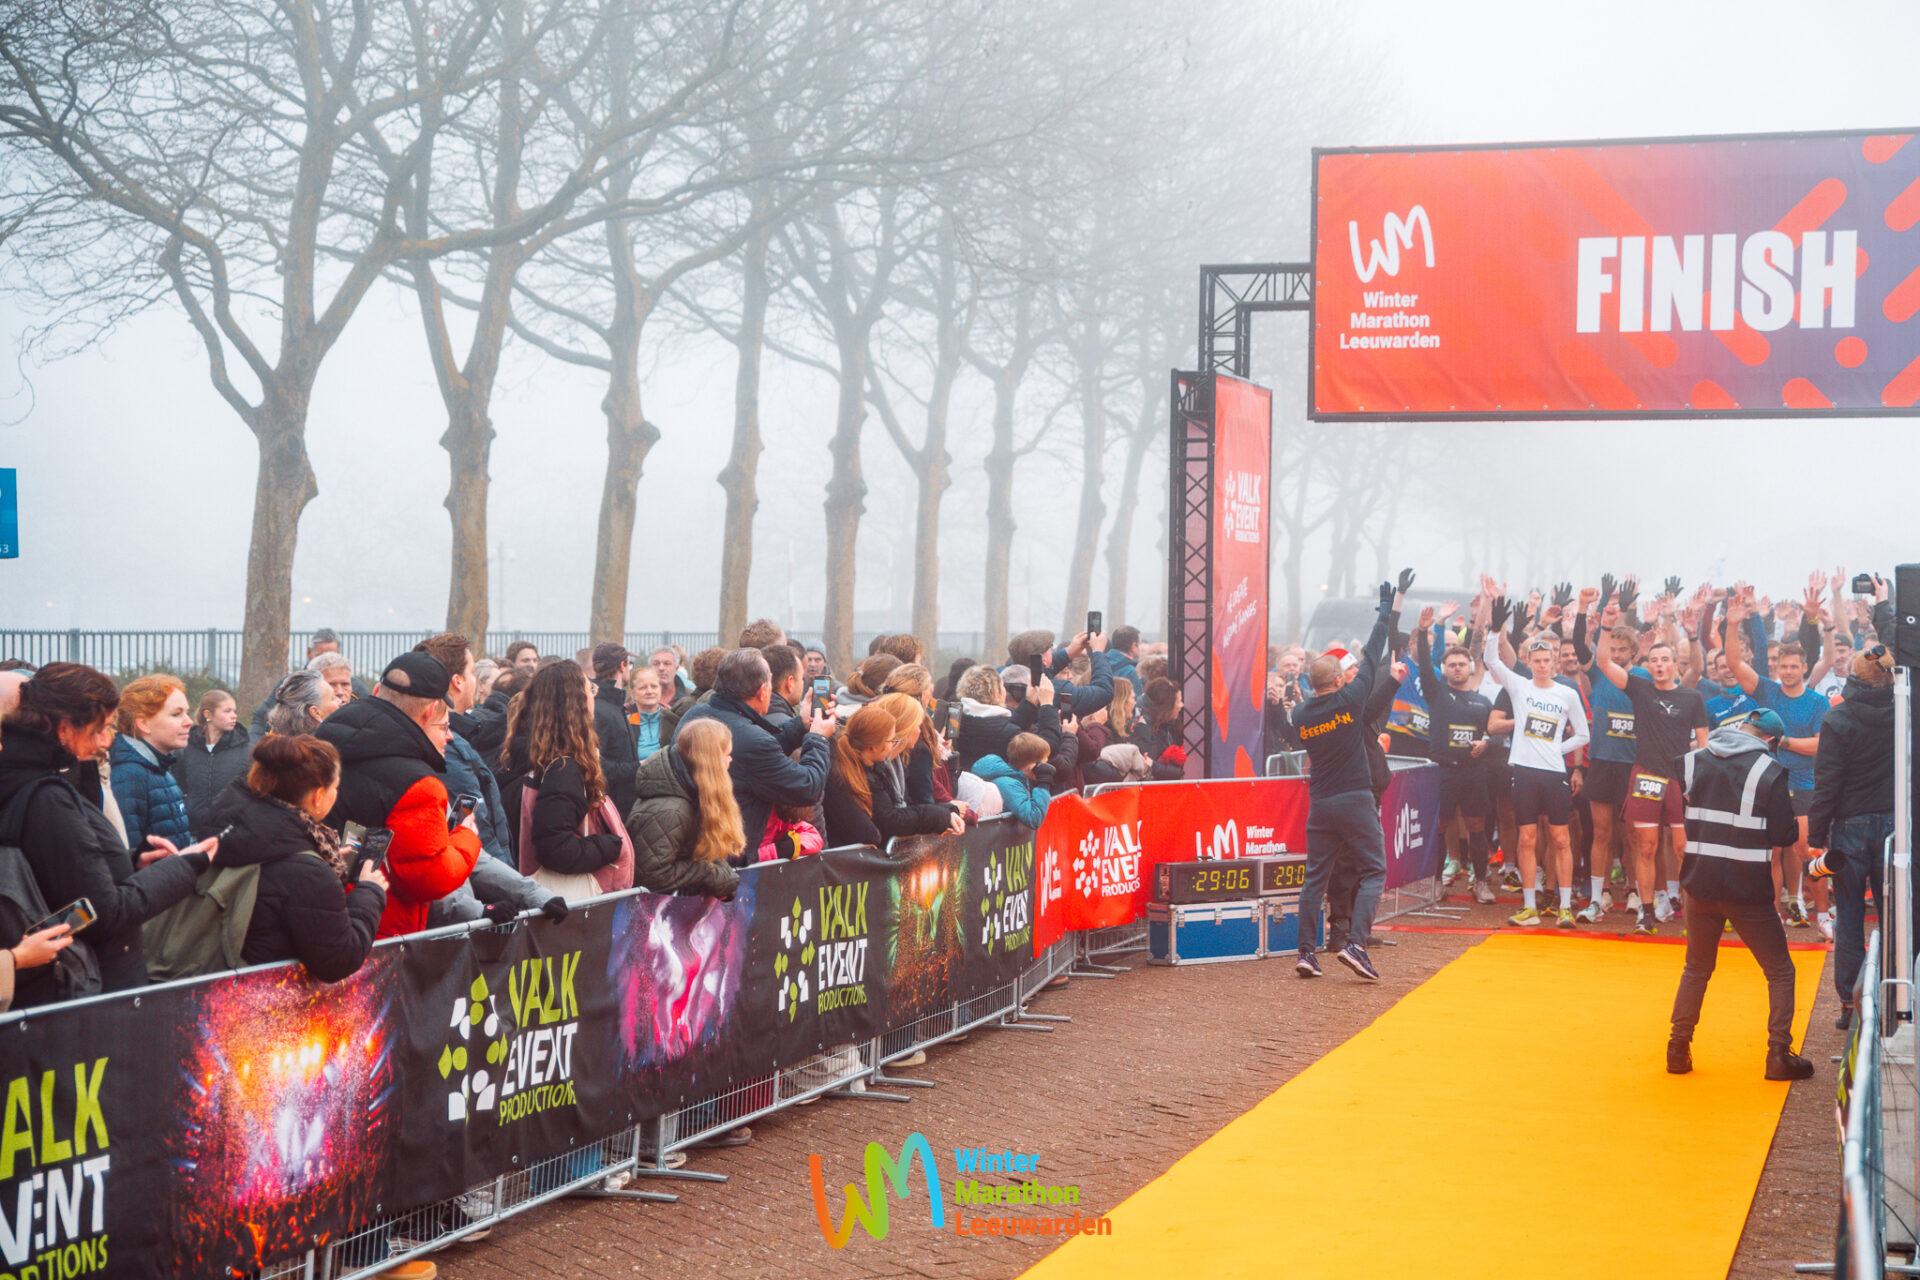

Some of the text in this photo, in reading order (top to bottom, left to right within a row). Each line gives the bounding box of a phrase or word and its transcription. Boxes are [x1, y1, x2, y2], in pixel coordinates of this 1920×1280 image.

[1576, 229, 1858, 334] FINISH
[1362, 290, 1419, 309] Winter
[1350, 310, 1431, 329] Marathon
[1339, 330, 1441, 350] Leeuwarden
[1237, 471, 1262, 505] VALK
[1235, 503, 1261, 531] EVENT
[1245, 841, 1286, 855] Marathon
[1246, 826, 1275, 839] Winter
[1102, 851, 1142, 884] EVE
[819, 880, 869, 941] VALK
[1003, 889, 1029, 933] EVEN
[818, 938, 868, 991] EVENT
[508, 950, 583, 1033] VALK
[0, 1056, 110, 1181] ALK
[499, 1079, 577, 1127] PRODUCTIONS
